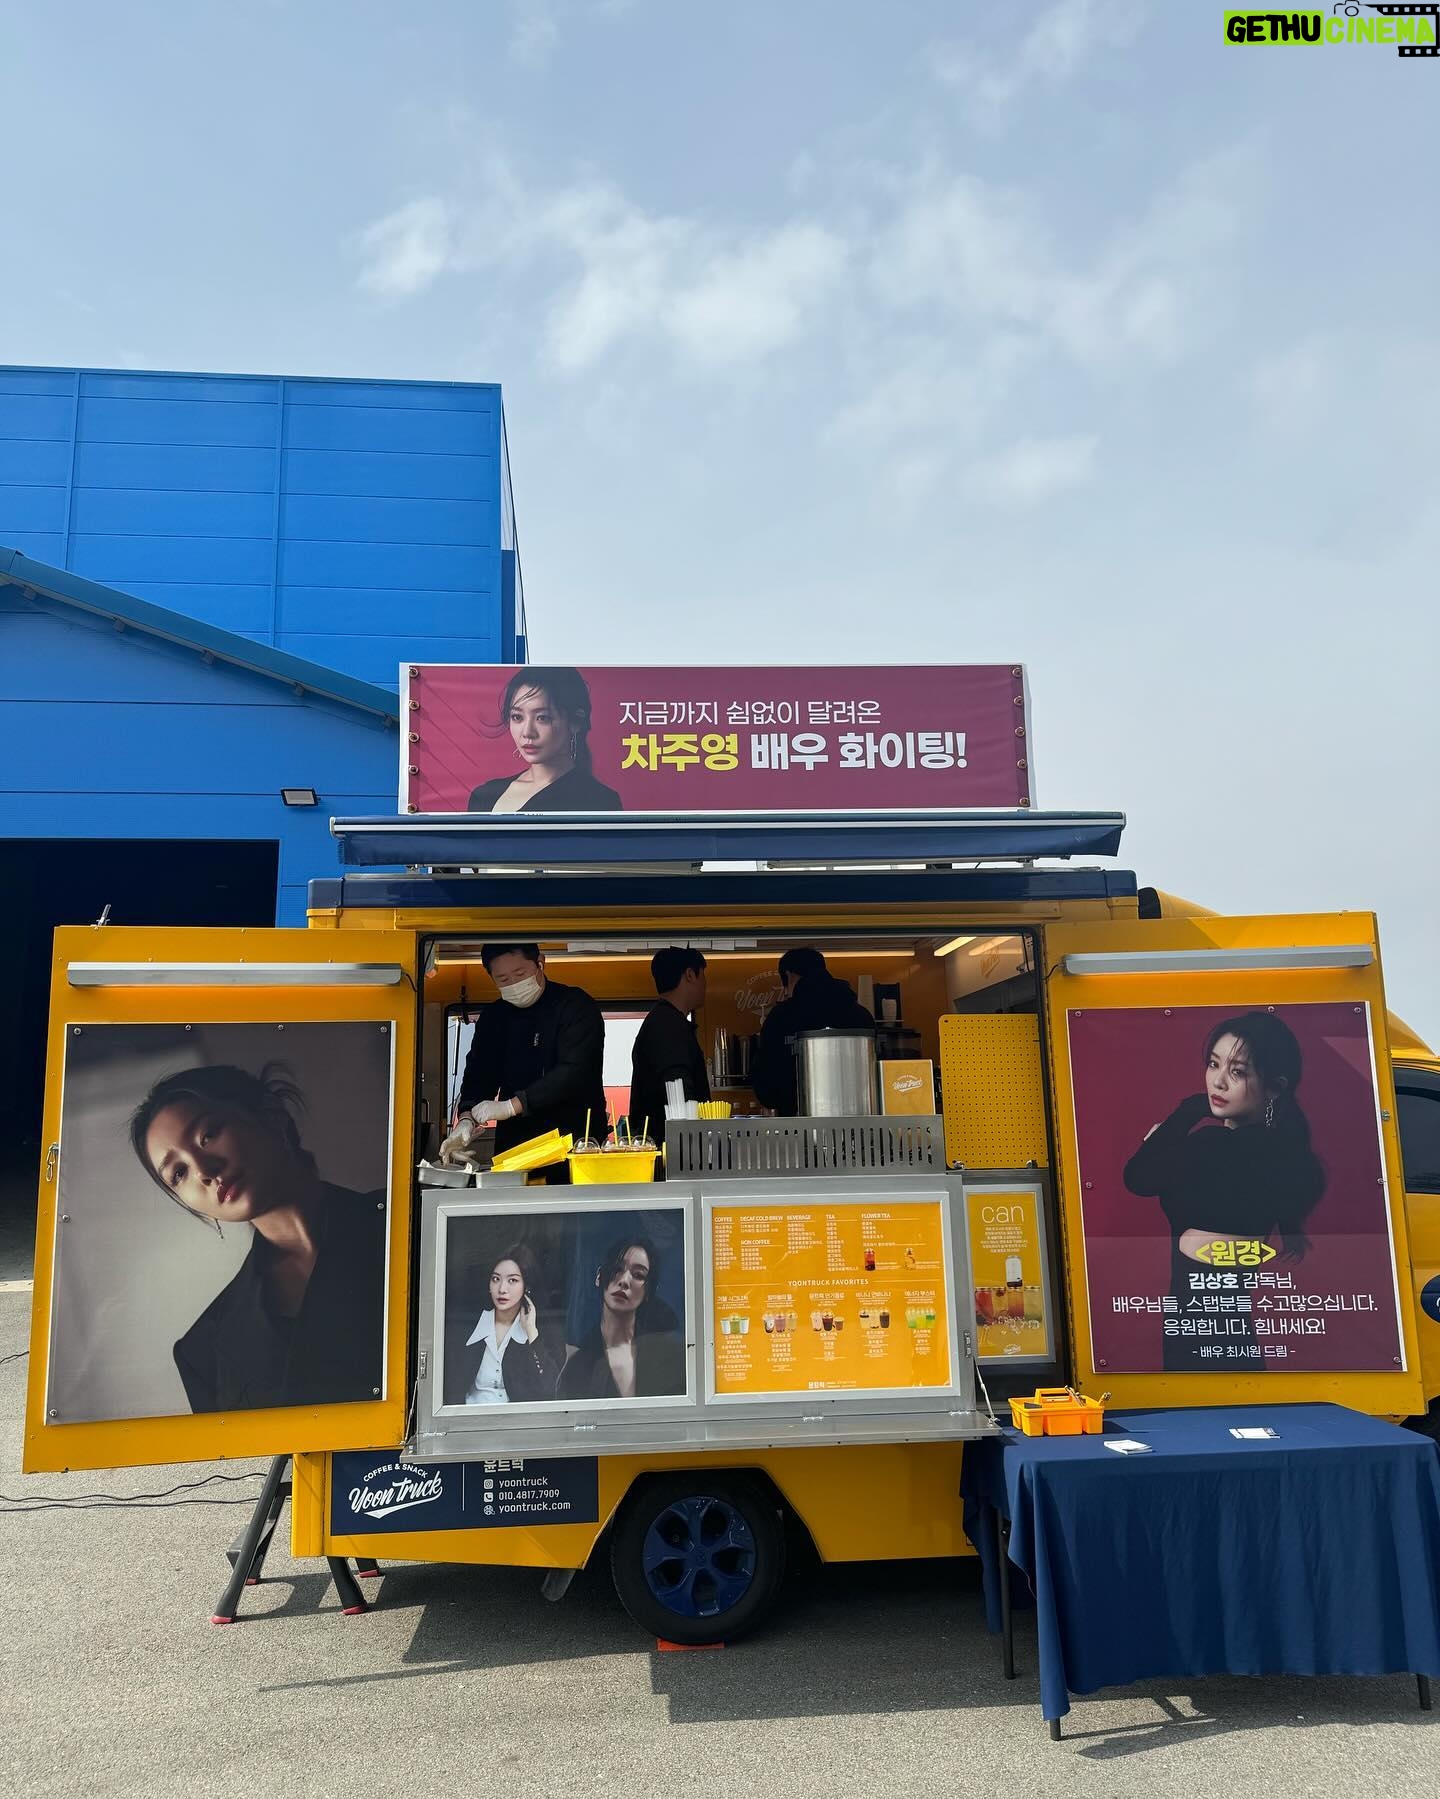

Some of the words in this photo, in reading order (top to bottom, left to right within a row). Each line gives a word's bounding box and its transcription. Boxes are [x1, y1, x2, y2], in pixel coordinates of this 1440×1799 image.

[618, 700, 719, 726] 지금까지
[725, 700, 801, 726] 쉼없이
[807, 700, 882, 725] 달려온
[621, 732, 740, 772] 차주영
[750, 732, 829, 771] 배우
[838, 731, 969, 770] 화이팅!
[981, 1204, 1025, 1225] can
[788, 1279, 831, 1287] YOONTRUCK
[832, 1277, 870, 1286] FAVORITES
[1188, 1273, 1239, 1290] 김상호
[1242, 1272, 1297, 1291] 감독님,
[1112, 1296, 1183, 1314] 배우님들,
[1186, 1295, 1252, 1313] 스탭분들
[1256, 1294, 1379, 1312] 수고많으십니다.
[1163, 1318, 1251, 1336] 응원합니다.
[1254, 1317, 1326, 1336] 힘내세요!
[1200, 1346, 1224, 1358] 배우
[1226, 1346, 1262, 1358] 최시원
[1264, 1345, 1288, 1358] 드림
[363, 1463, 393, 1482] COFFEE
[394, 1463, 401, 1471] &
[402, 1463, 428, 1479] SNACK
[498, 1477, 548, 1488] yoontruck
[349, 1485, 395, 1513] Yoon
[498, 1489, 560, 1501] 010.4817.7909
[498, 1502, 571, 1514] yoontruck.com
